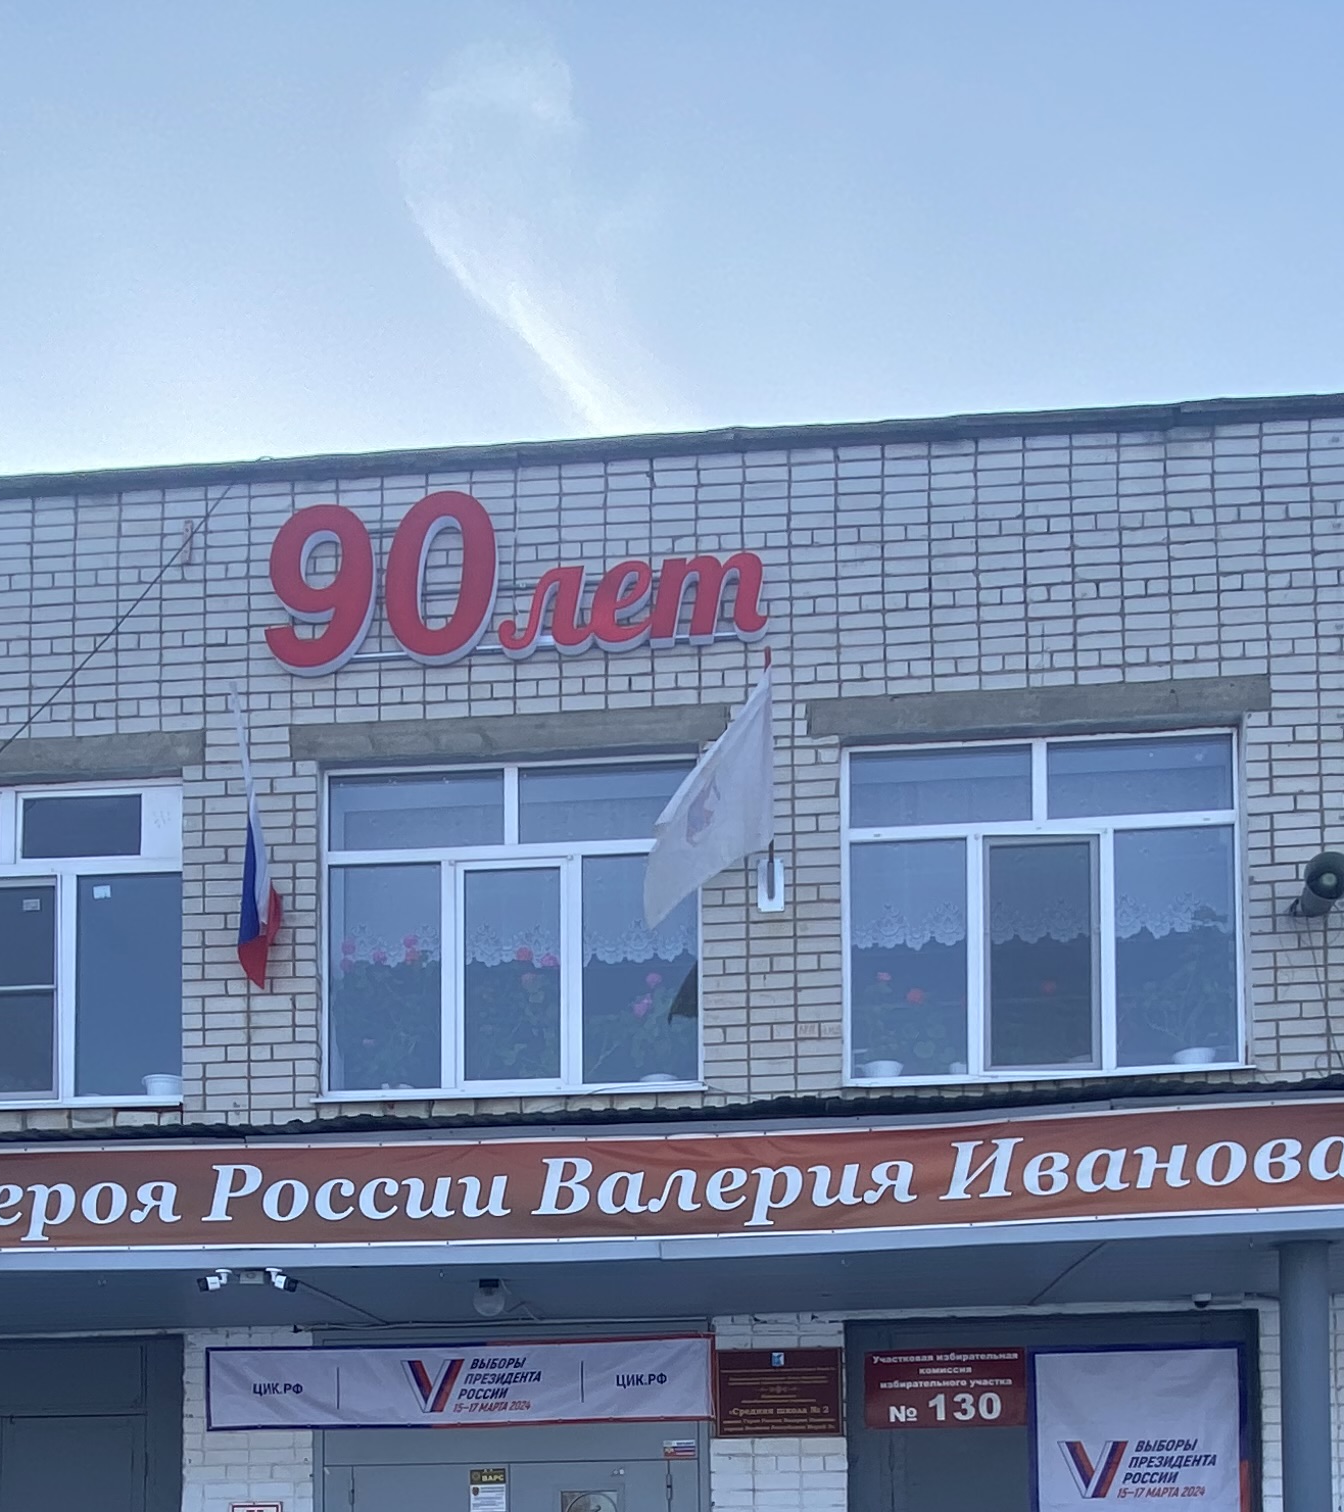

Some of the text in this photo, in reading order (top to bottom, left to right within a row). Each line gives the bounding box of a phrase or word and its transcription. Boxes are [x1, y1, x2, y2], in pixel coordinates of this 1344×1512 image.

[264, 490, 768, 677] 90 лет
[201, 1163, 513, 1222] России
[531, 1156, 919, 1227] Валерия
[469, 1357, 527, 1370] ВЫБОРЫ
[872, 1352, 1019, 1364] Участковая избирательная
[918, 1366, 973, 1375] комиссия
[463, 1370, 543, 1386] ПРЕЗИДЕНТА
[615, 1373, 668, 1389] ЦИК.РФ
[879, 1378, 1013, 1390] избирательного участка
[252, 1382, 303, 1396] ЦИК.РФ
[457, 1387, 509, 1400] РОССИИ
[478, 1401, 508, 1412] МАРТА
[508, 1400, 531, 1411] 2024
[822, 1405, 830, 1414] 2
[889, 1392, 1002, 1423] № 130
[1134, 1439, 1199, 1453] ВЫБОРЫ
[1127, 1454, 1218, 1470] ПРЕЗИДЕНТА
[1122, 1471, 1180, 1485] РОССИИ
[1144, 1486, 1180, 1498] МАРТА
[1180, 1486, 1206, 1498] 2024
